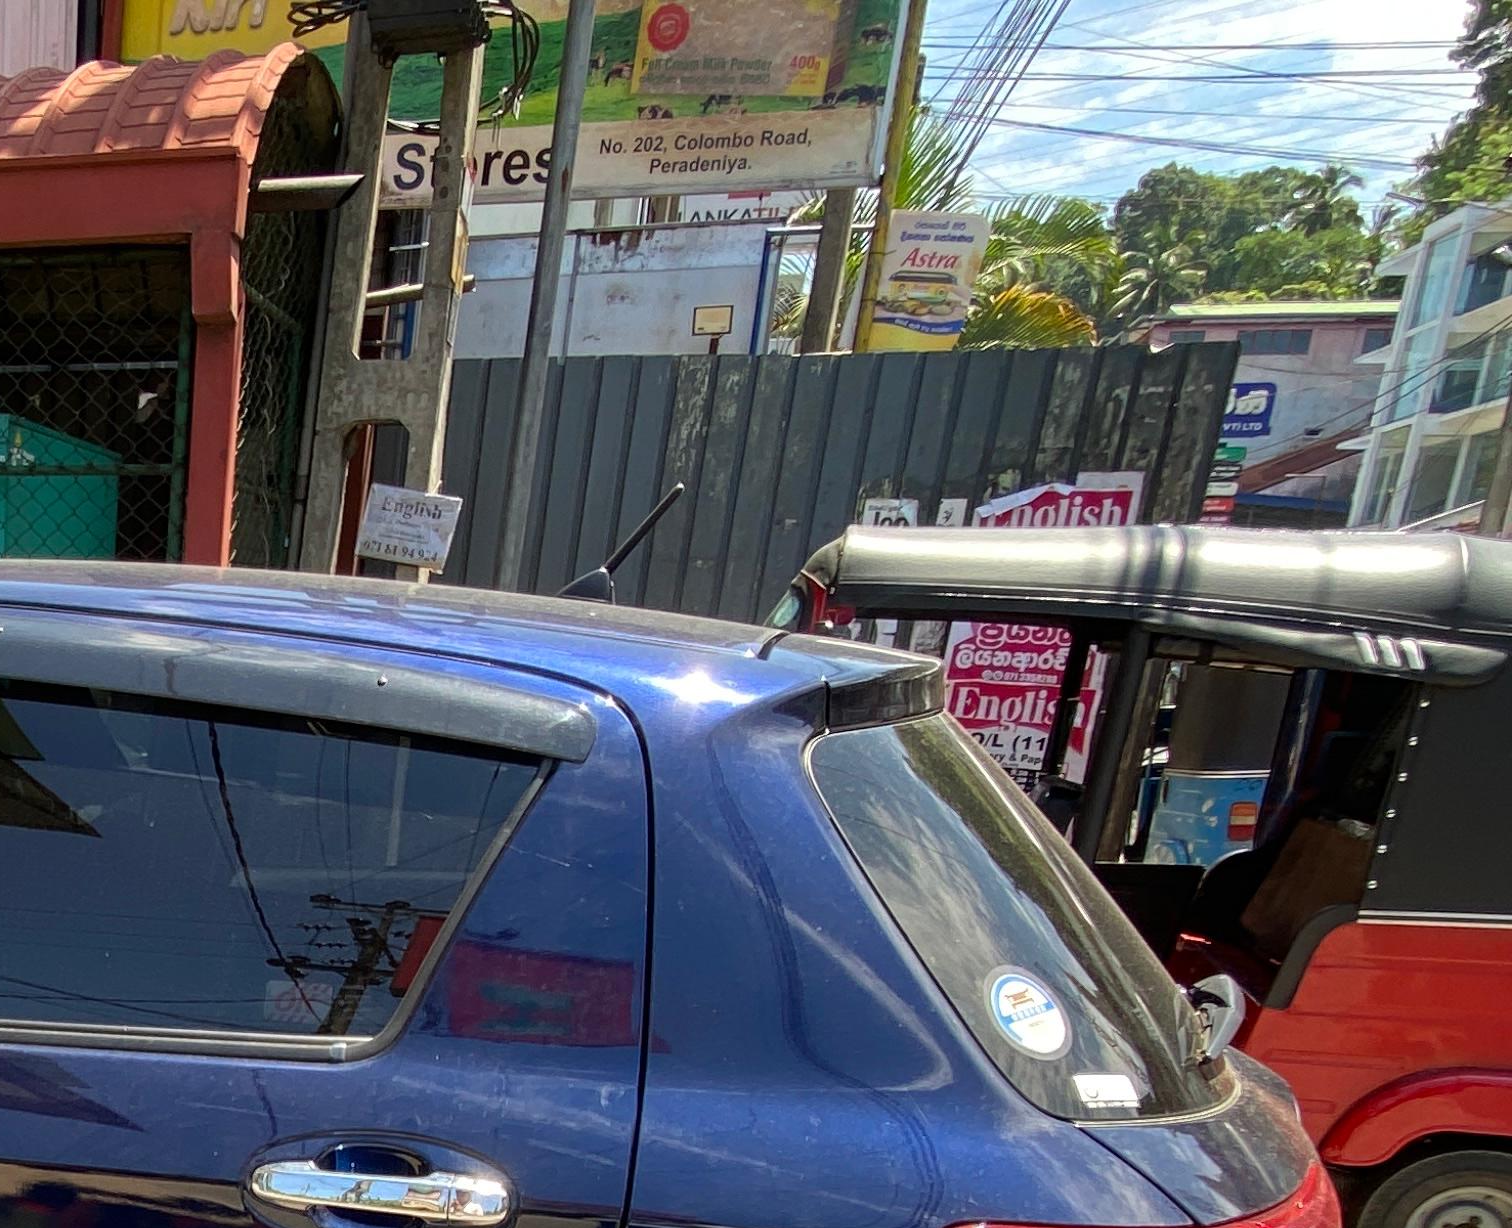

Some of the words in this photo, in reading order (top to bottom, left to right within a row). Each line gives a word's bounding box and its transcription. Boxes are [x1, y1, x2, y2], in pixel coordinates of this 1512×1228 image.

[789, 56, 822, 71] 400g
[599, 138, 627, 155] No.
[633, 136, 667, 154] 202,
[674, 131, 754, 151] Colombo
[760, 128, 813, 148] Road,
[649, 157, 753, 175] Peradeniya.
[901, 247, 959, 269] Astra
[1242, 422, 1263, 430] LTD
[381, 496, 442, 520] English
